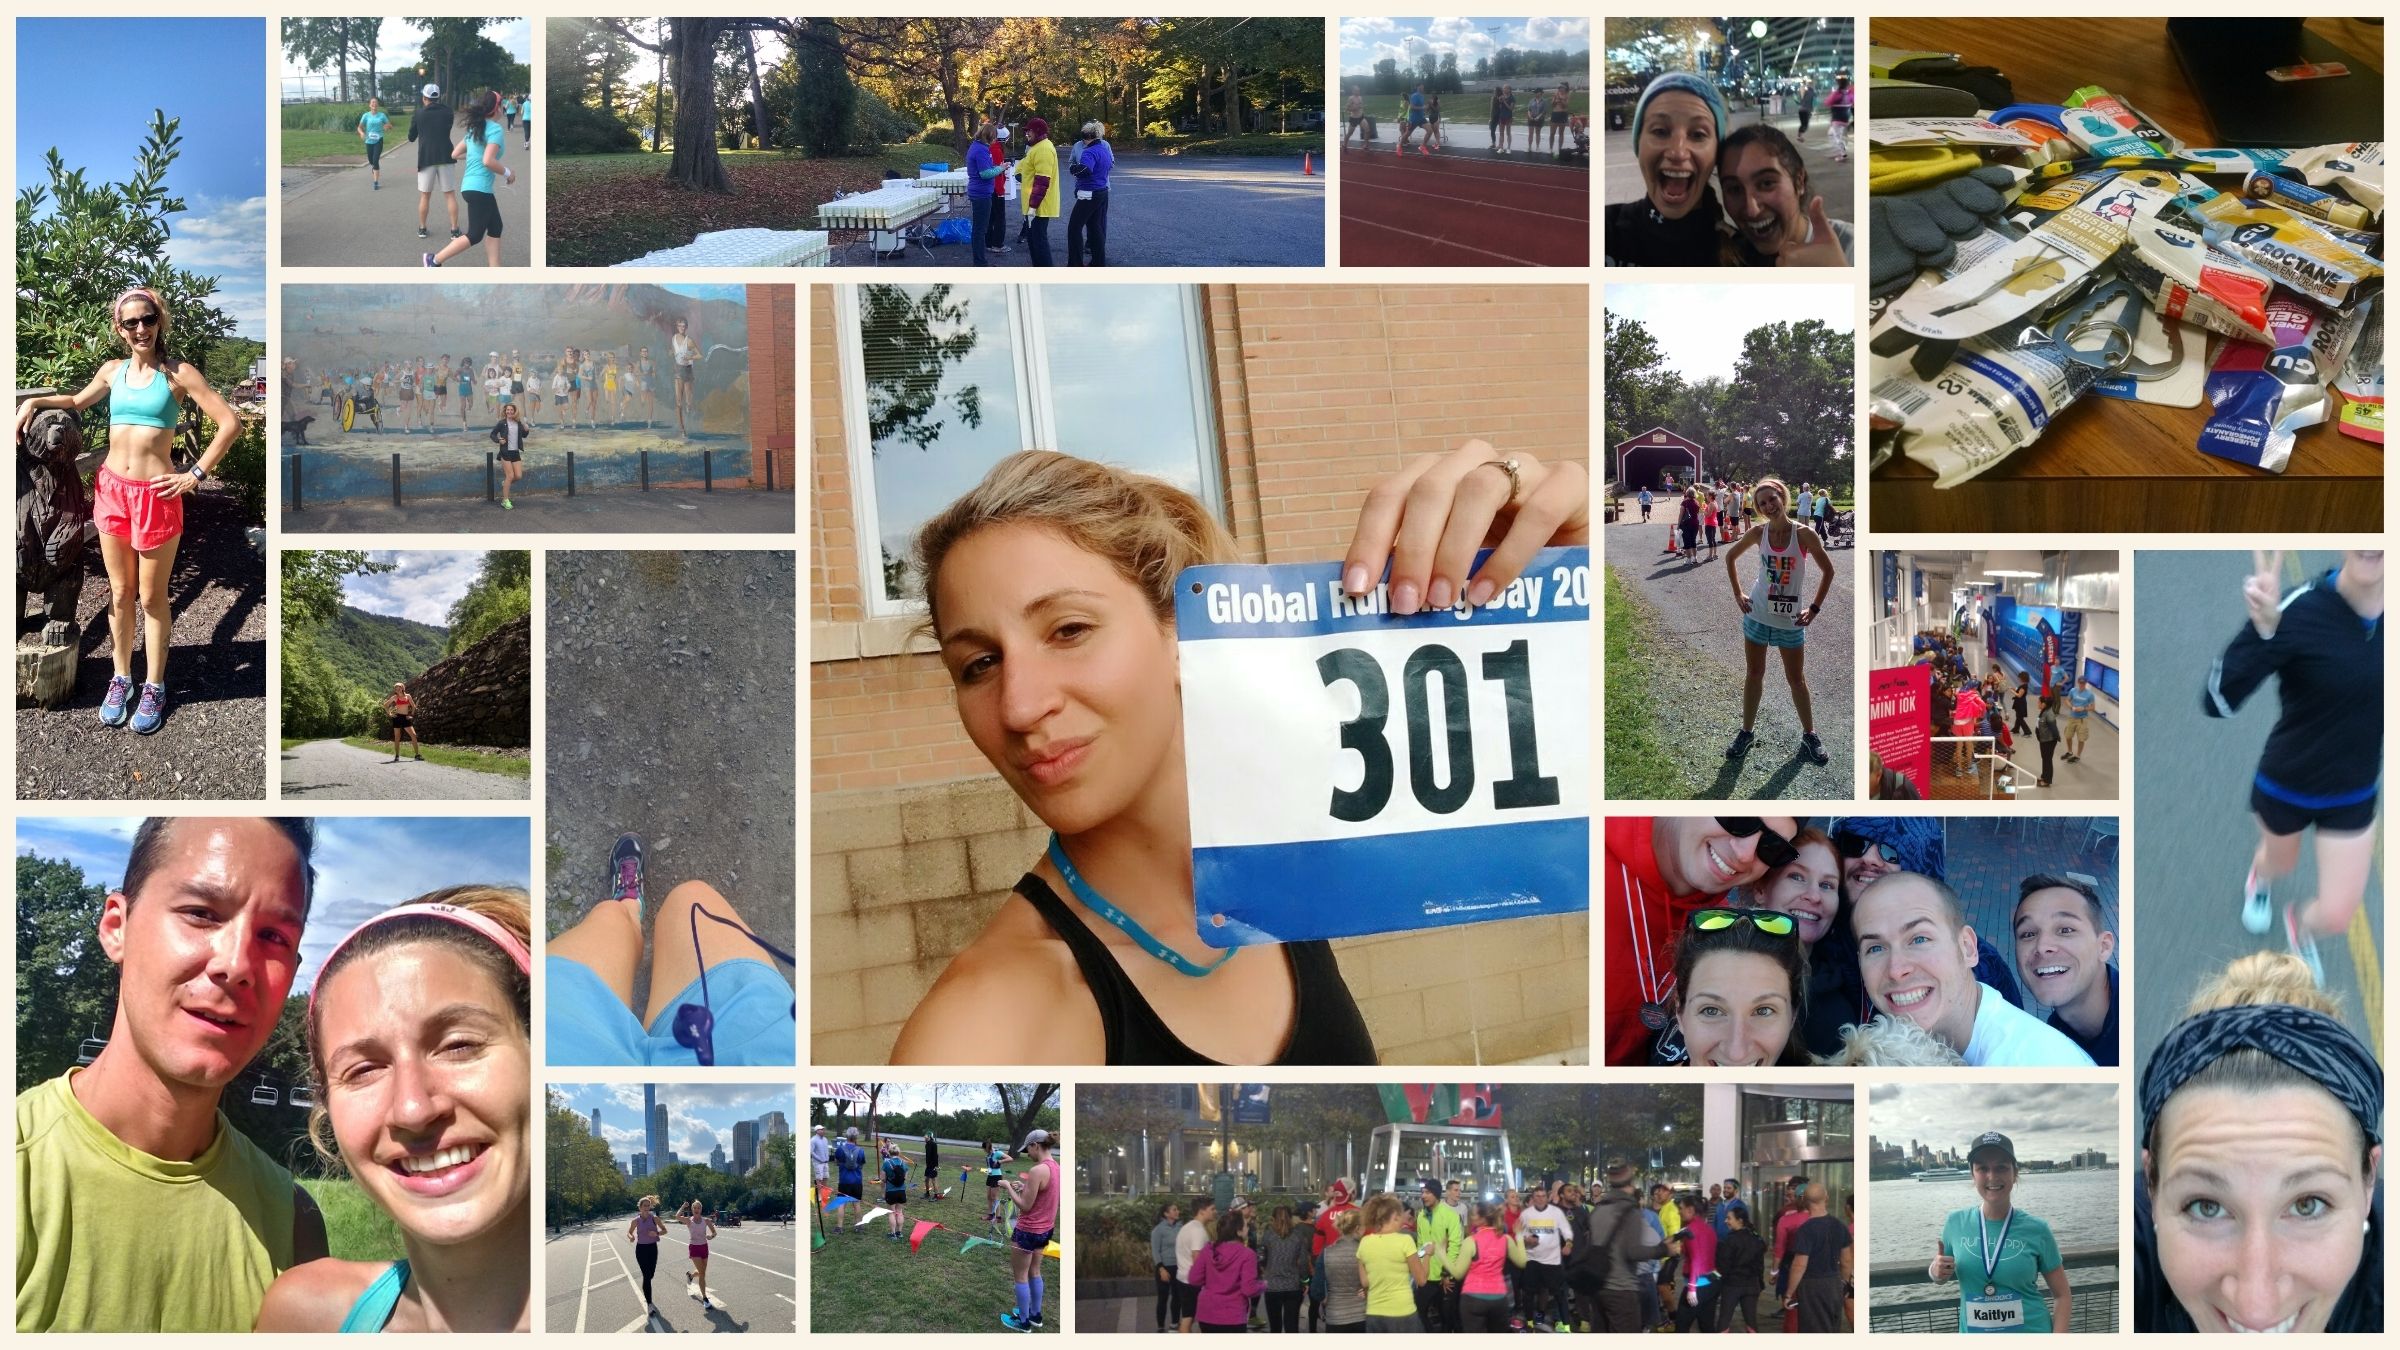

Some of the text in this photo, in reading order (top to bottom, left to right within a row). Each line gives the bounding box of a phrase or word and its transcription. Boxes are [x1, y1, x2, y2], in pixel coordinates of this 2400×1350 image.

[2136, 129, 2161, 138] GU
[2060, 213, 2121, 247] ORBITER
[2067, 207, 2128, 242] ADJUSTABLE
[2239, 225, 2270, 242] GU
[2261, 242, 2343, 289] ROCTANE
[2254, 253, 2279, 271] ULTRA
[2280, 266, 2336, 297] ENDURANCE
[2271, 354, 2316, 377] GU
[2205, 427, 2261, 443] POMEGRANATE
[2215, 434, 2259, 448] BLUEBERRY
[1761, 554, 1799, 571] NEVER
[1766, 569, 1791, 585] GIVE
[1206, 581, 1317, 624] Global
[1773, 602, 1793, 613] 170
[1870, 699, 1896, 721] MINI
[1315, 639, 1560, 823] 301
[810, 1082, 867, 1100] INISH
[1974, 1308, 2015, 1322] Kaitlyn
